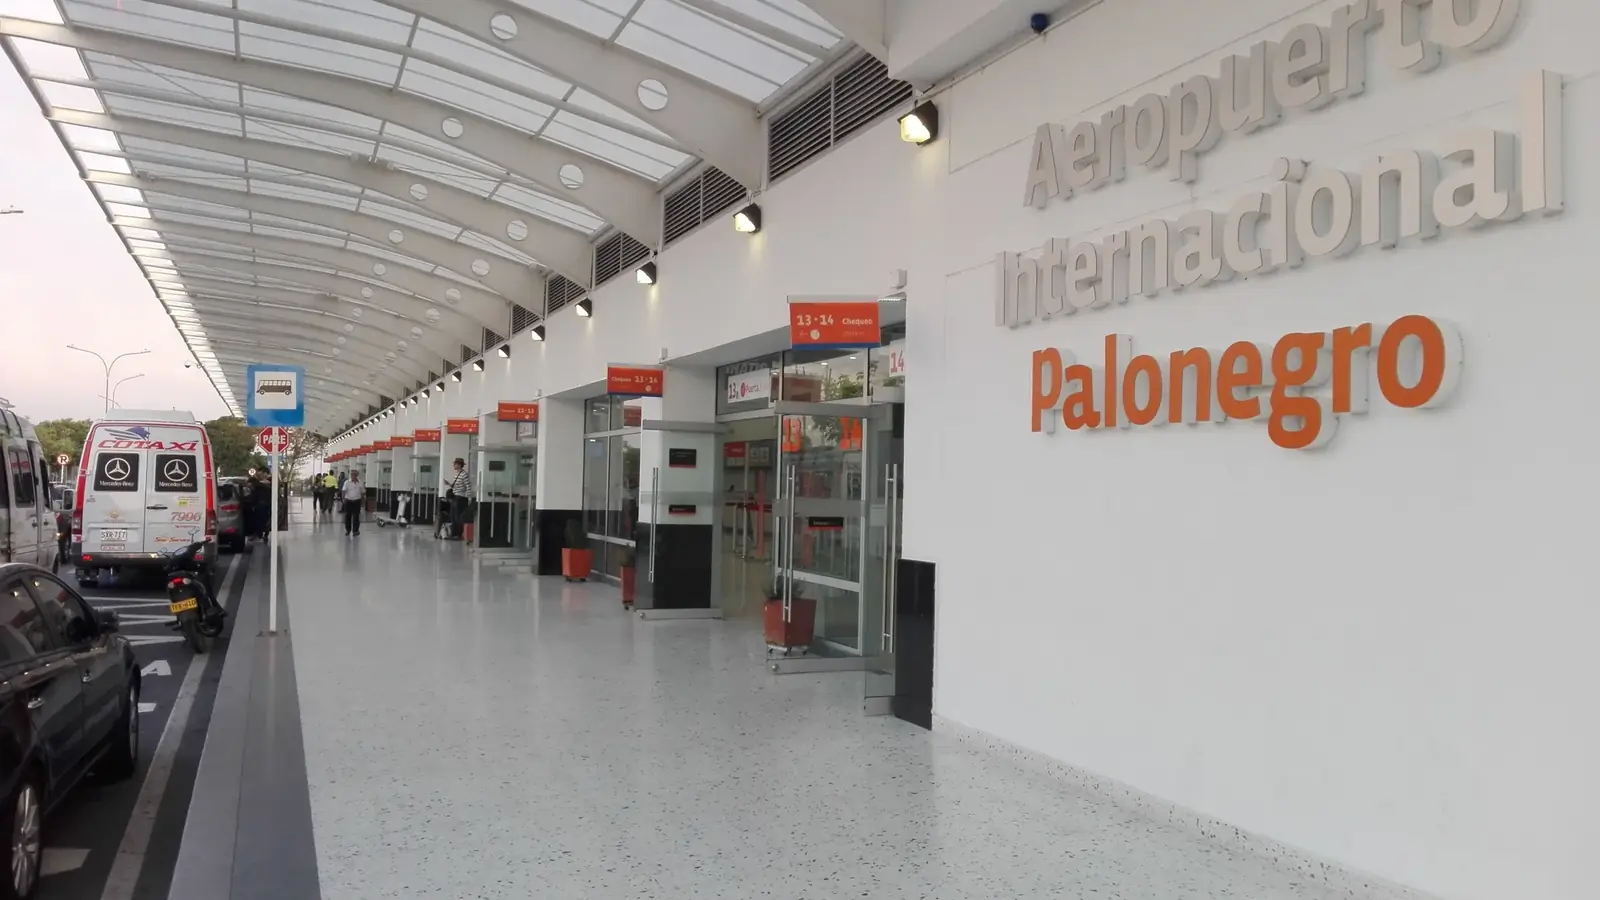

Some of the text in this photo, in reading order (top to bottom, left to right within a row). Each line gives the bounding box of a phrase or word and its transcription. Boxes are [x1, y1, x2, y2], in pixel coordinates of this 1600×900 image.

[995, 69, 1553, 327] Internacional
[842, 317, 873, 326] Chequeo
[1031, 314, 1448, 449] Palonegro
